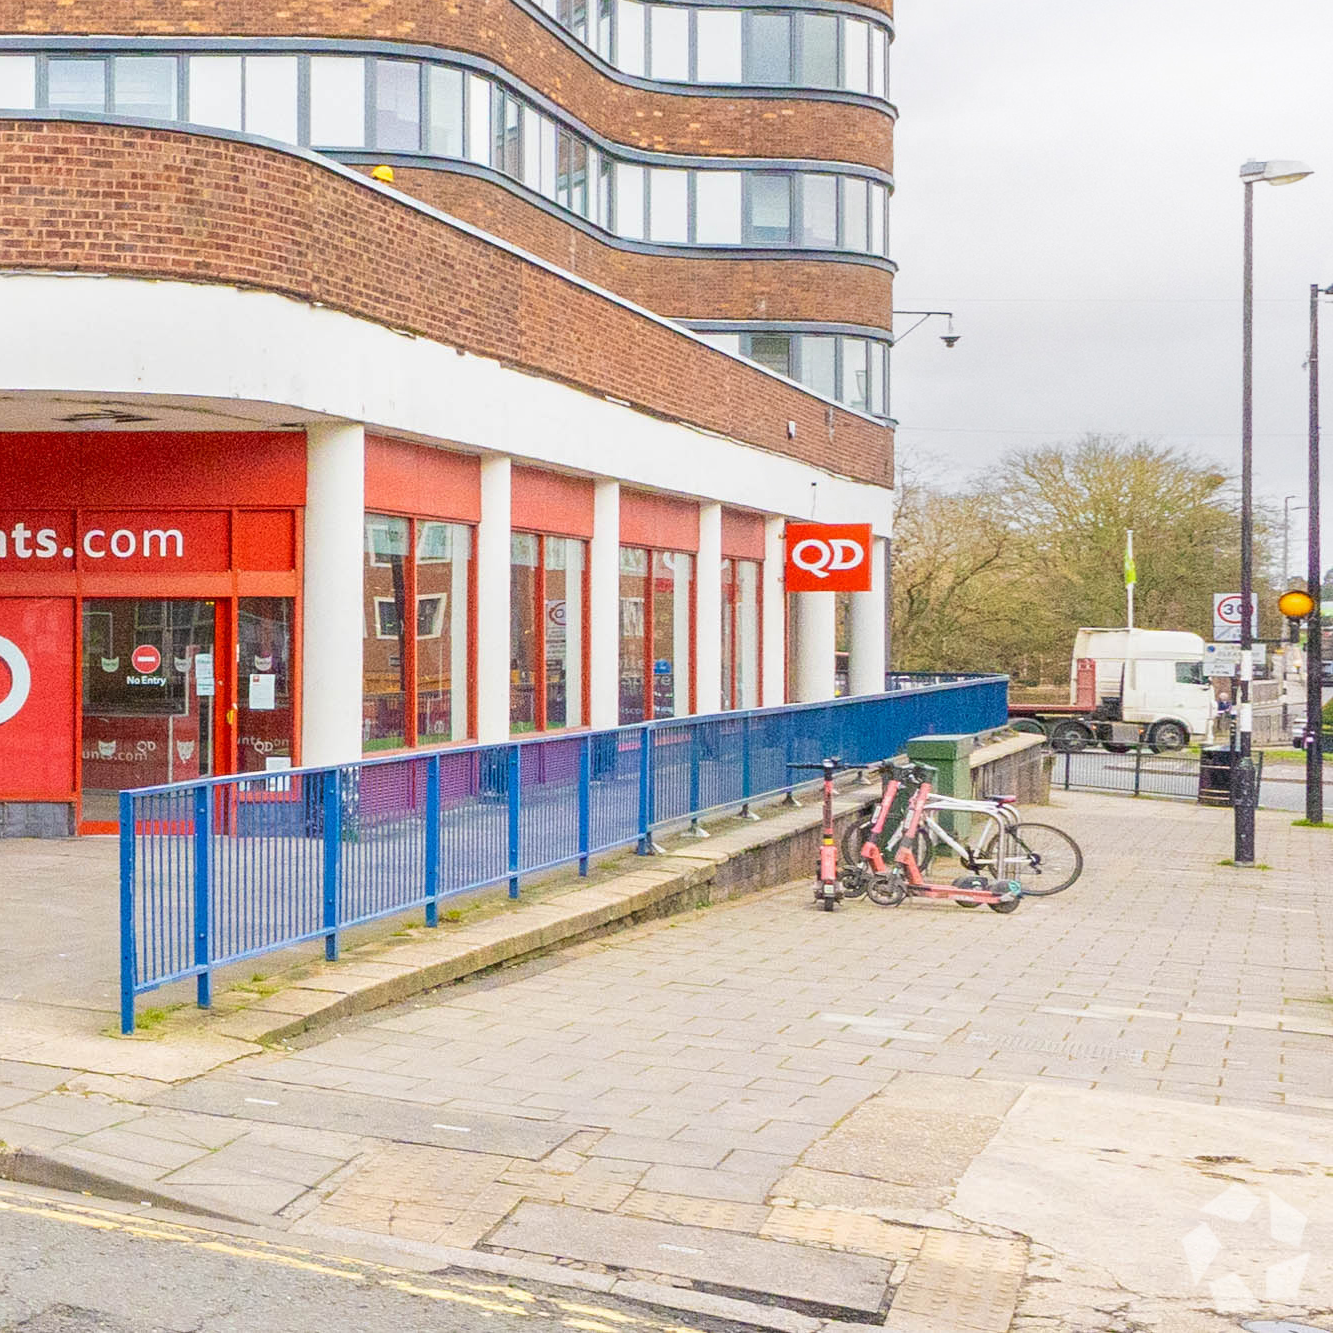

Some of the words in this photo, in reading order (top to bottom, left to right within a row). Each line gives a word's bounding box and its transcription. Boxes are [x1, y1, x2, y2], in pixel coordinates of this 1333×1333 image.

[792, 539, 864, 578] QD
[126, 675, 141, 685] No
[141, 675, 167, 687] Entry
